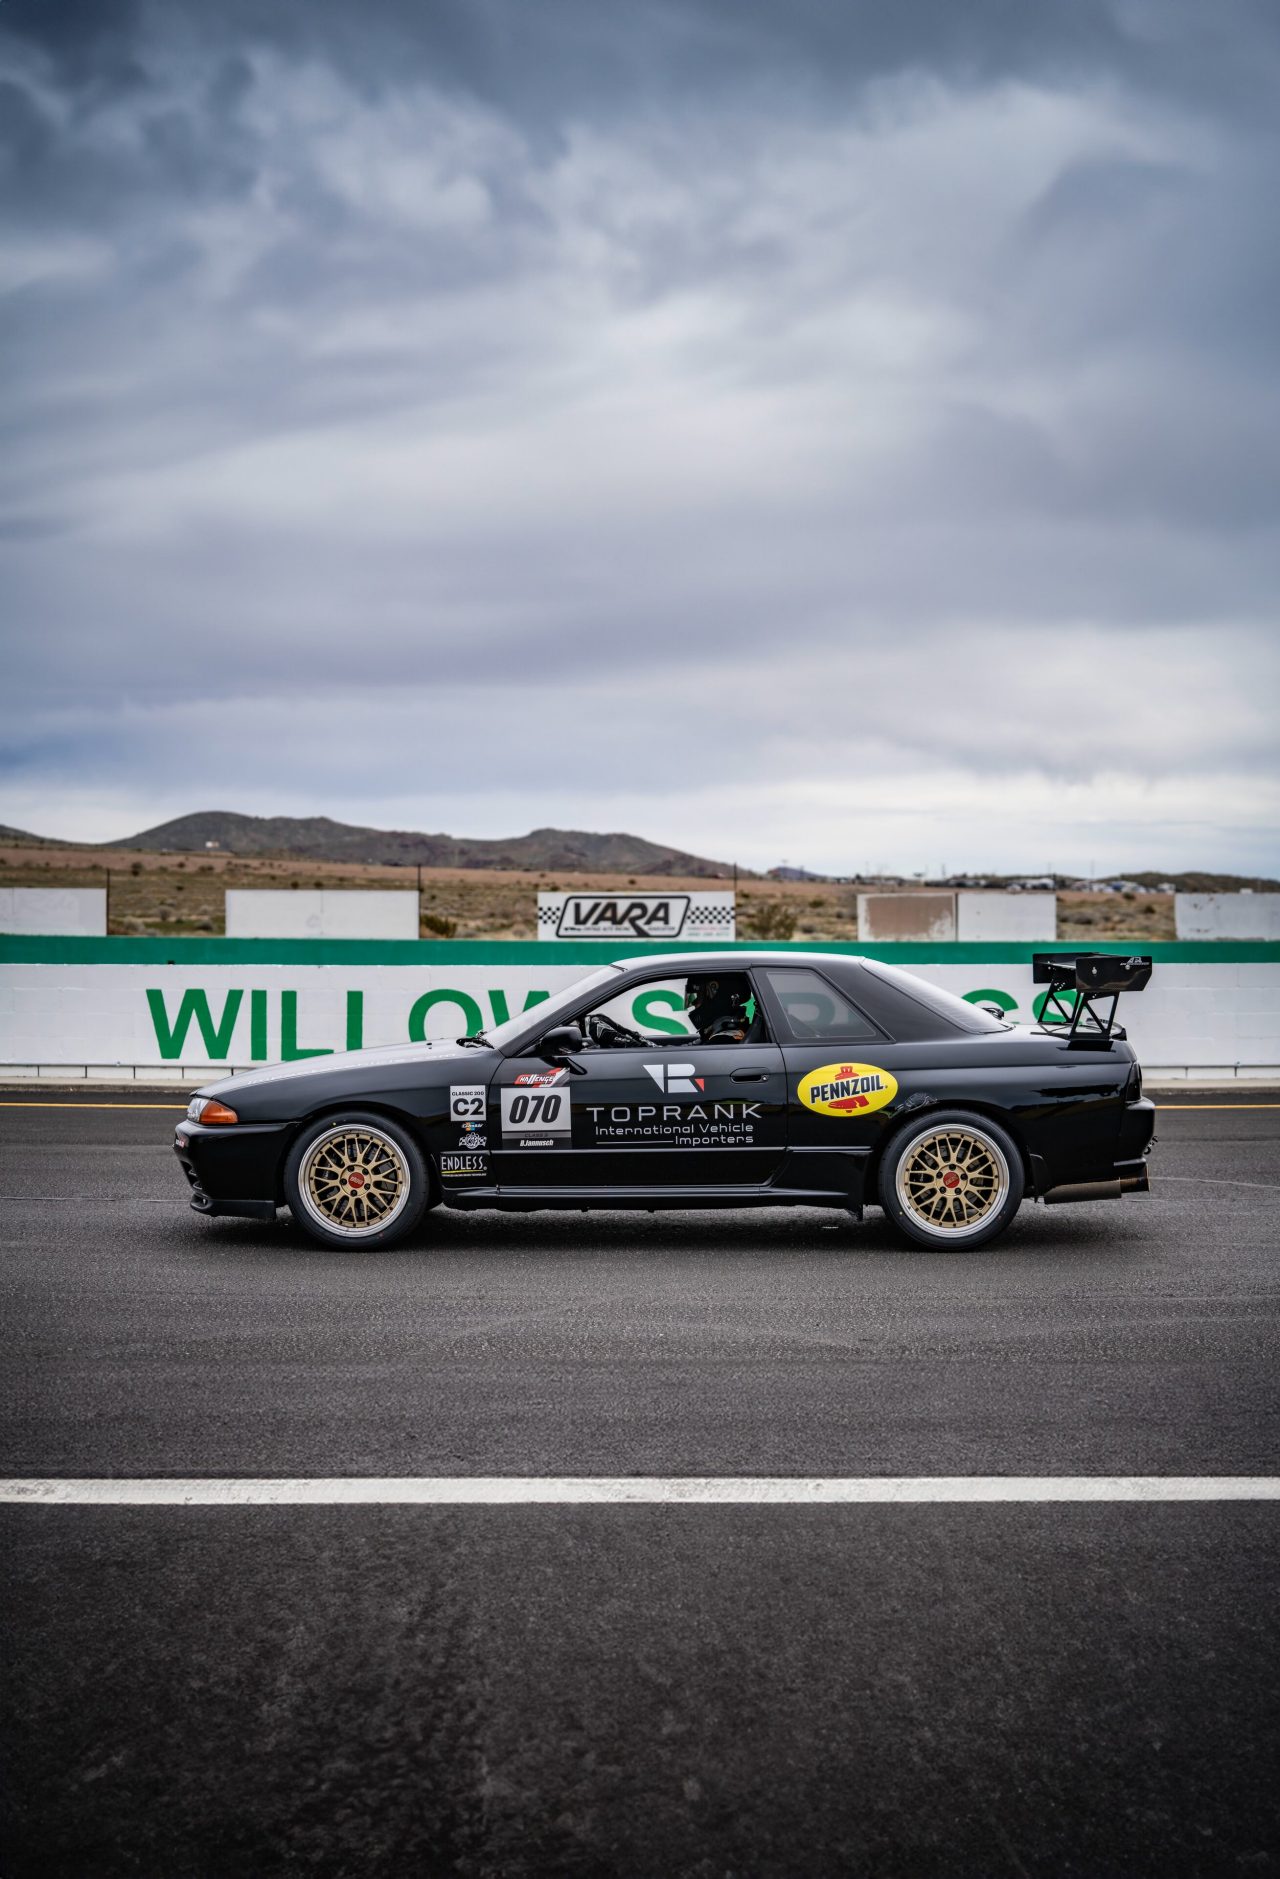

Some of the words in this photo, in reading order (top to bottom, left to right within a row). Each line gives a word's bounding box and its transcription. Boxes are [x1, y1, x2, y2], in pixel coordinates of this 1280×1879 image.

[574, 902, 669, 937] VARA
[810, 1075, 884, 1104] PENNZOIL
[452, 1098, 485, 1116] C2
[509, 1095, 561, 1124] 070
[586, 1104, 763, 1122] TOPRANK
[595, 1124, 694, 1136] International
[700, 1123, 754, 1133] Vehicle
[675, 1136, 754, 1147] Importers
[441, 1156, 483, 1171] ENDLESS
